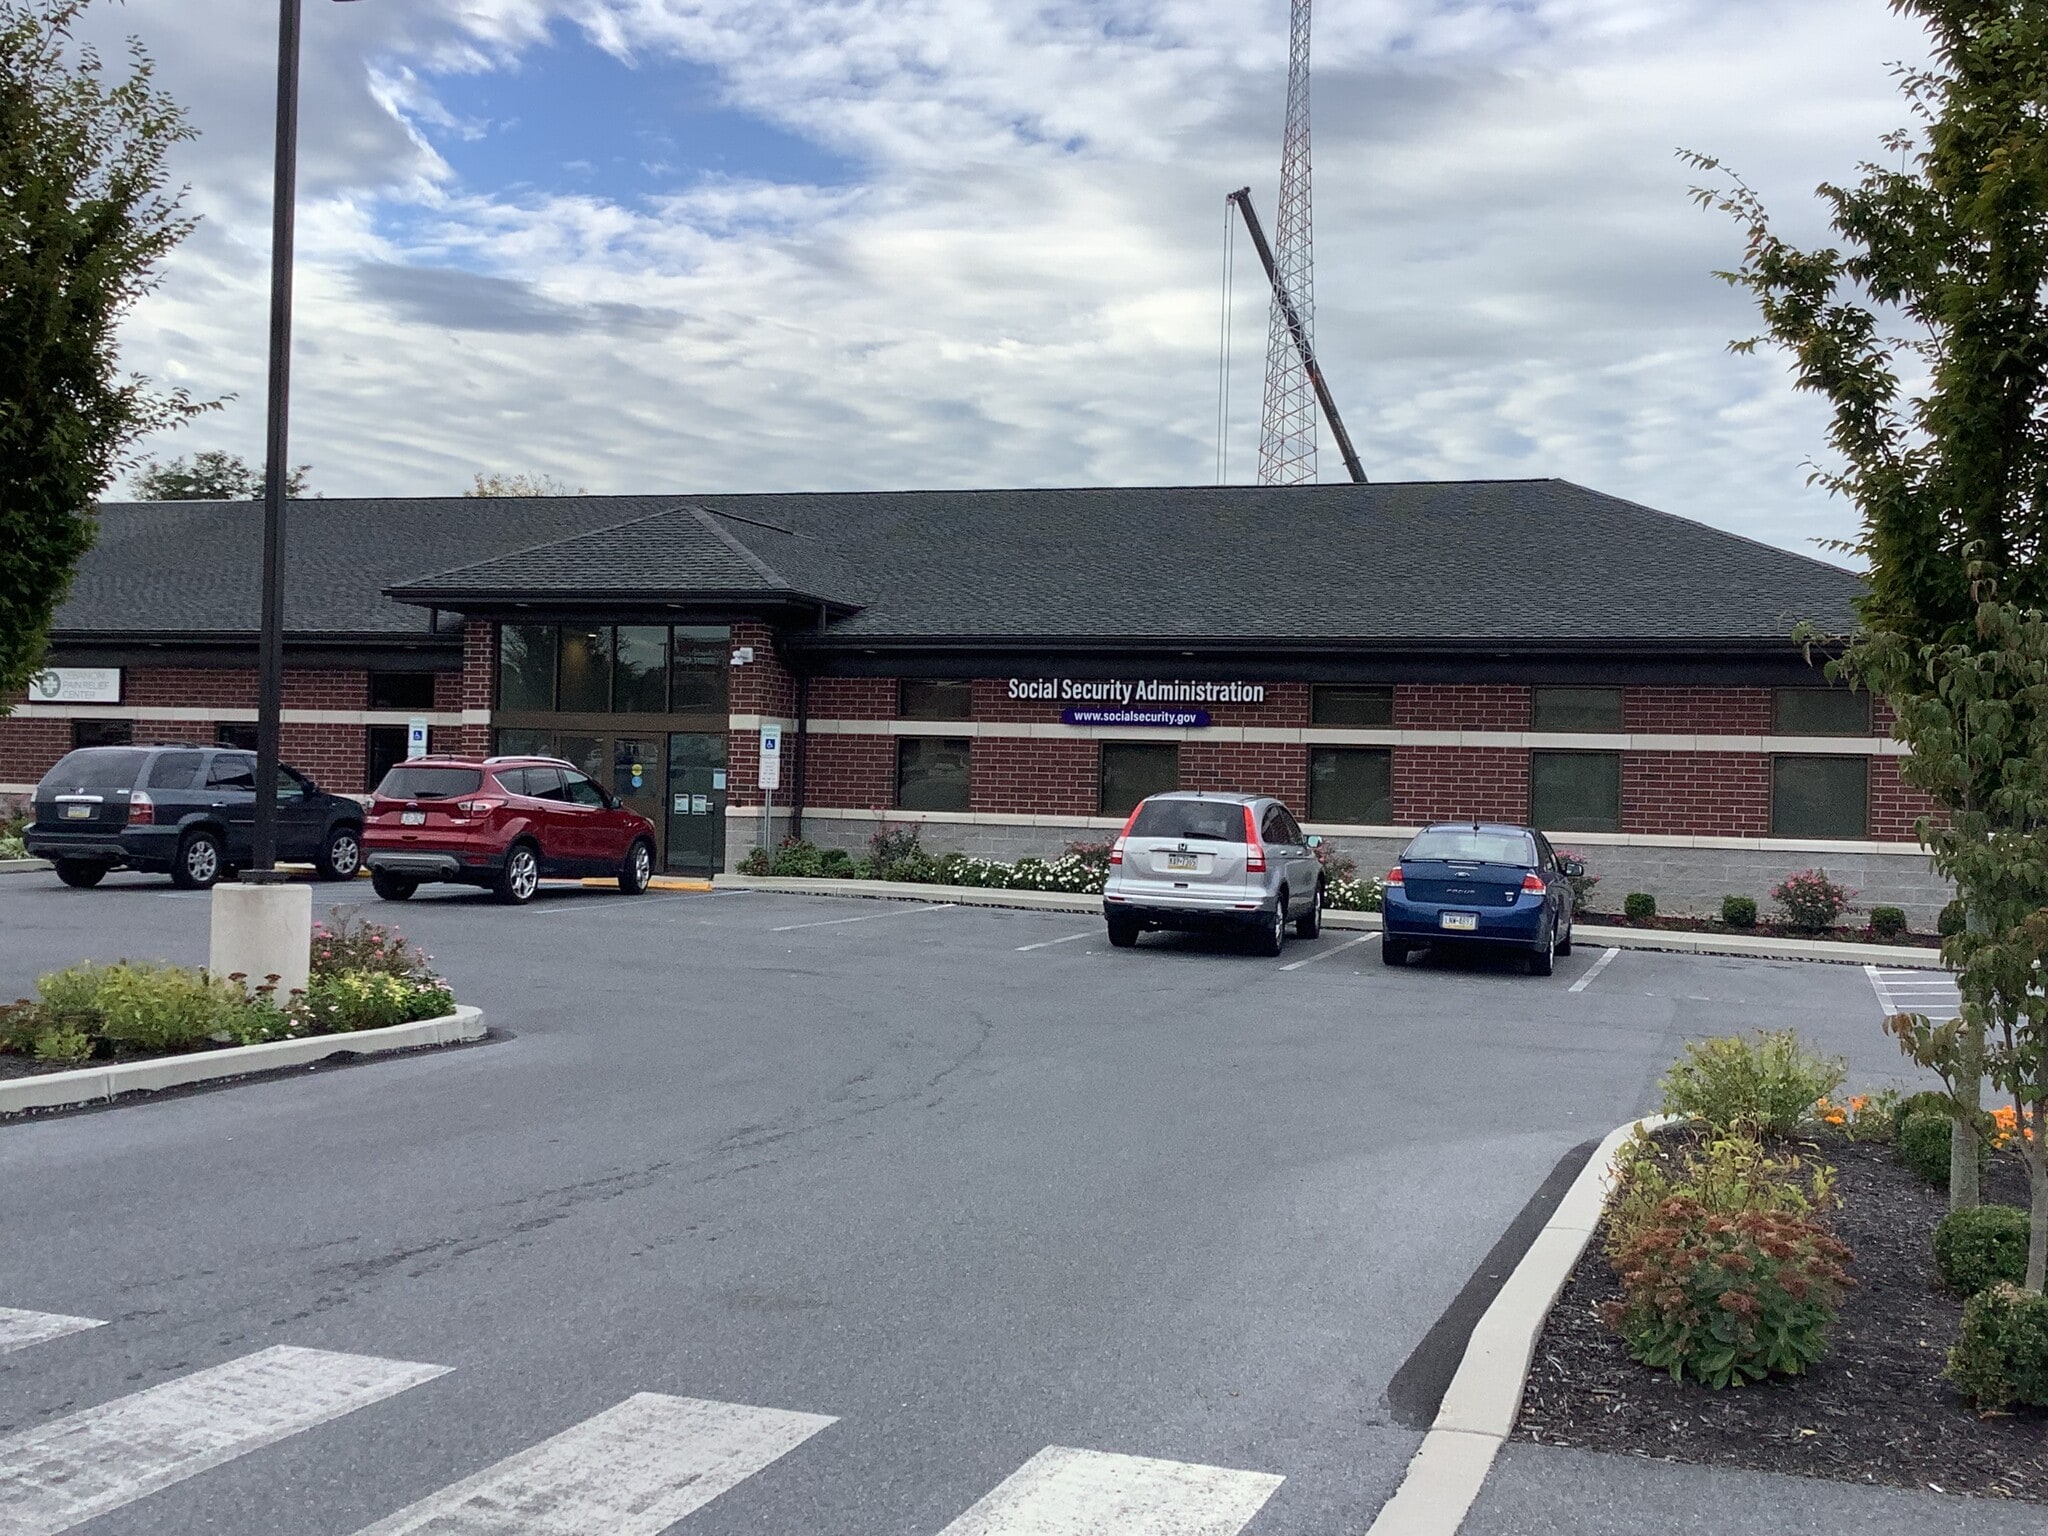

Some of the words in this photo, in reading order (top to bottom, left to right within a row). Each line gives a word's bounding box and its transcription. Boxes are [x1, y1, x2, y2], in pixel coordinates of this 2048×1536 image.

[62, 680, 81, 690] PAIN
[83, 681, 110, 690] RELIEF
[62, 690, 96, 699] CENTER
[1008, 678, 1058, 699] Social
[1061, 679, 1132, 705] Security
[1135, 679, 1264, 702] Administration
[1074, 710, 1197, 725] www.socialsecurity.gov
